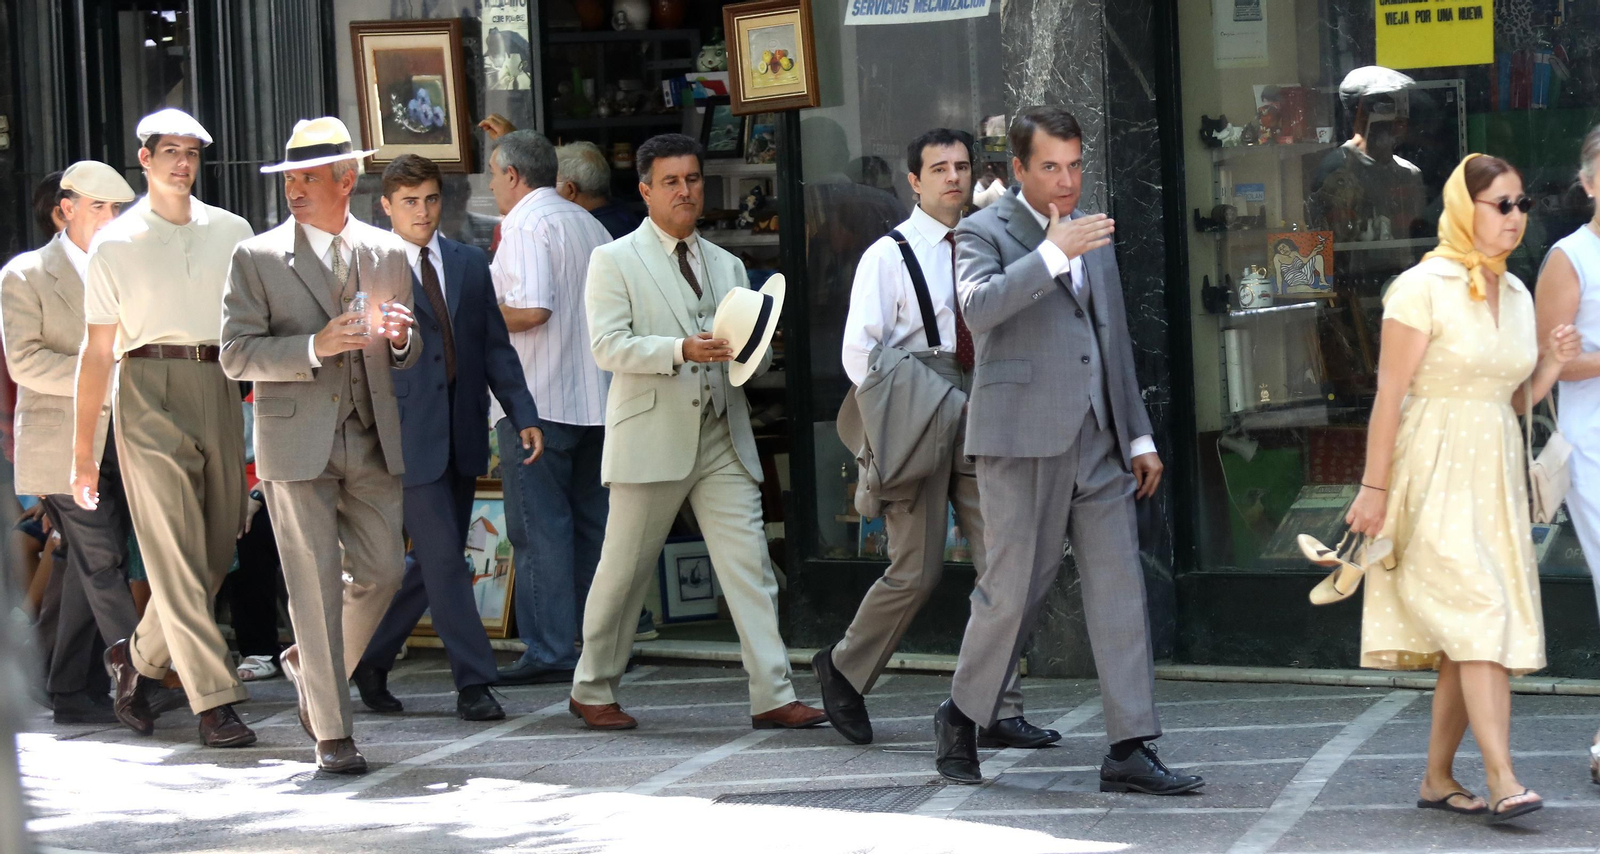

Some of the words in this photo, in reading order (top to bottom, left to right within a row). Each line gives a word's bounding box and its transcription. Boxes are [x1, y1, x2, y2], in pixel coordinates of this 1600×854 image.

[852, 0, 909, 16] SERVICIOS
[1385, 11, 1409, 25] VIEJA
[1415, 9, 1431, 23] POR
[1437, 8, 1453, 22] UNA
[1458, 6, 1483, 21] NUEVA
